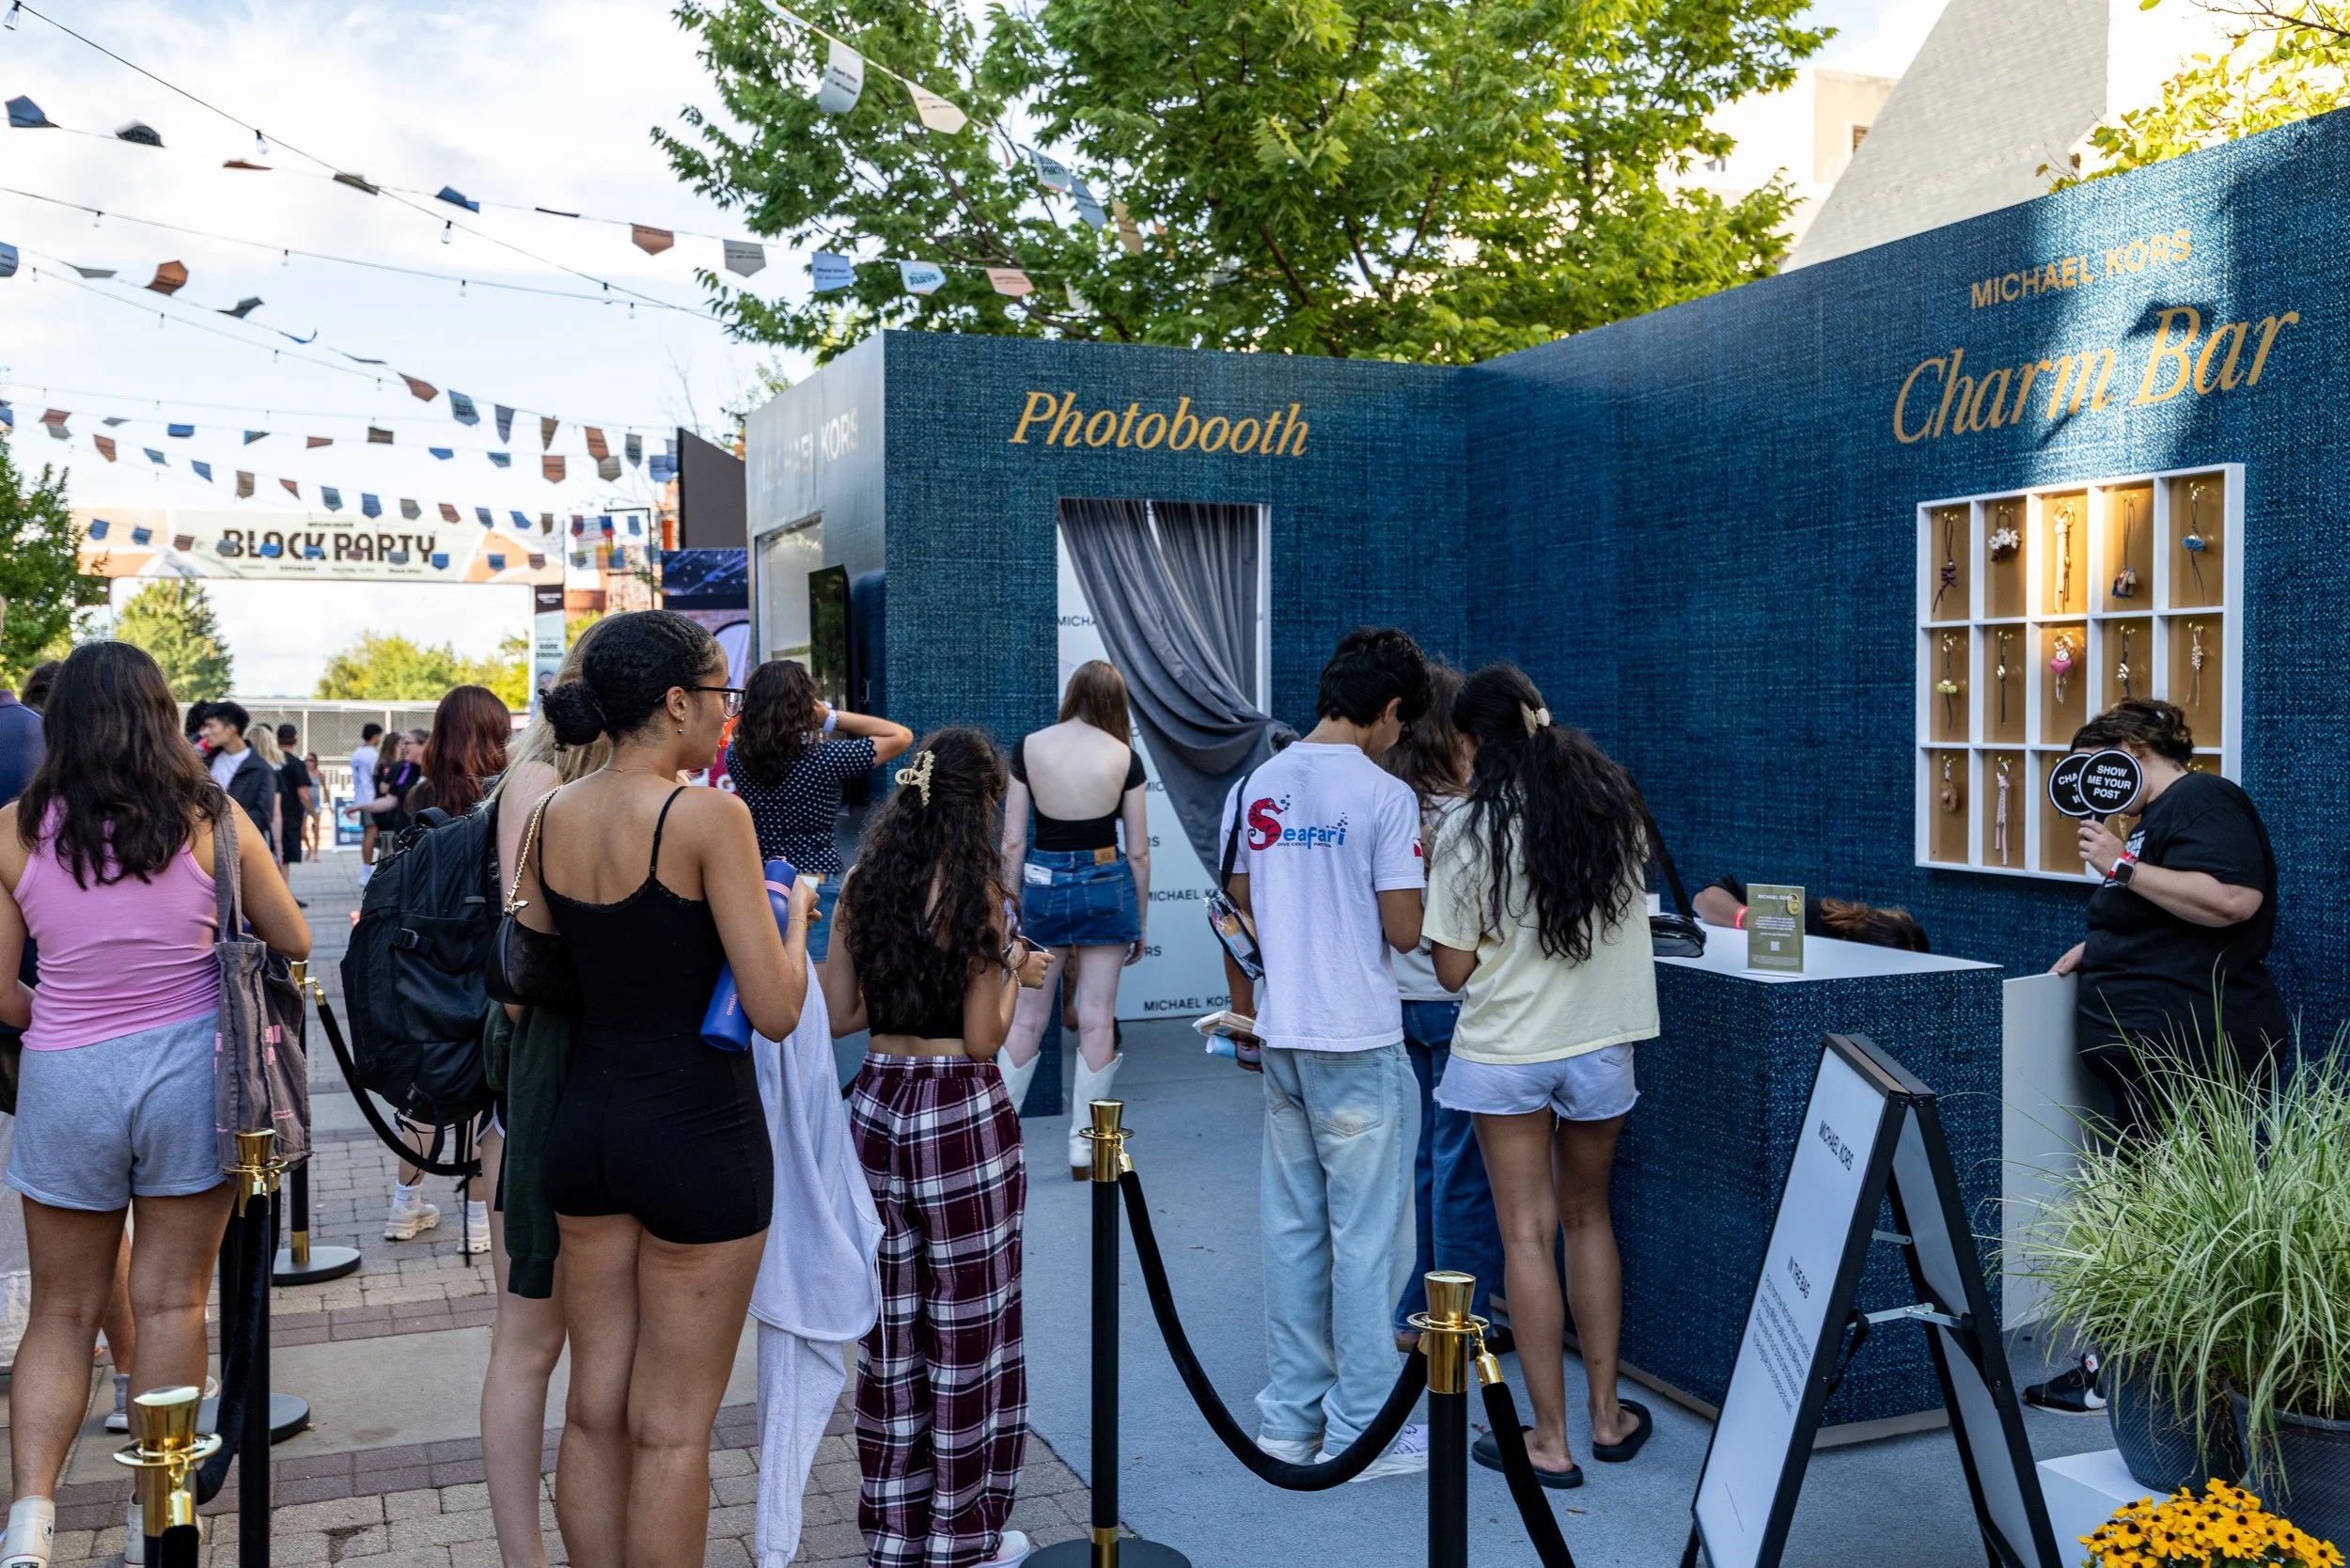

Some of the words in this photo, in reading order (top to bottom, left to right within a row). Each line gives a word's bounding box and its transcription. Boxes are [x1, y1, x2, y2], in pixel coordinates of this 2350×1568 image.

[1971, 257, 2095, 310] MICHAEL
[2105, 229, 2192, 278] KORS
[1893, 347, 2116, 445] Charm
[2129, 306, 2300, 408] Bar
[821, 407, 859, 463] KORS
[1008, 391, 1309, 457] Photobooth
[222, 529, 327, 561] BLOCK
[333, 533, 435, 564] PARTY
[1058, 616, 1096, 627] MICH
[2096, 764, 2128, 777] SHOW
[2087, 775, 2102, 786] ME
[2104, 776, 2132, 791] YOUR
[2092, 787, 2121, 800] POST
[1247, 797, 1347, 852] Seafari
[1144, 946, 1162, 957] RS
[727, 994, 737, 1015] owala
[1144, 997, 1201, 1011] MICHAEL
[1206, 996, 1231, 1007] KOR
[1819, 1120, 1841, 1155] MICHAEL
[1838, 1142, 1855, 1171] KORS
[1792, 1262, 1802, 1286] THE
